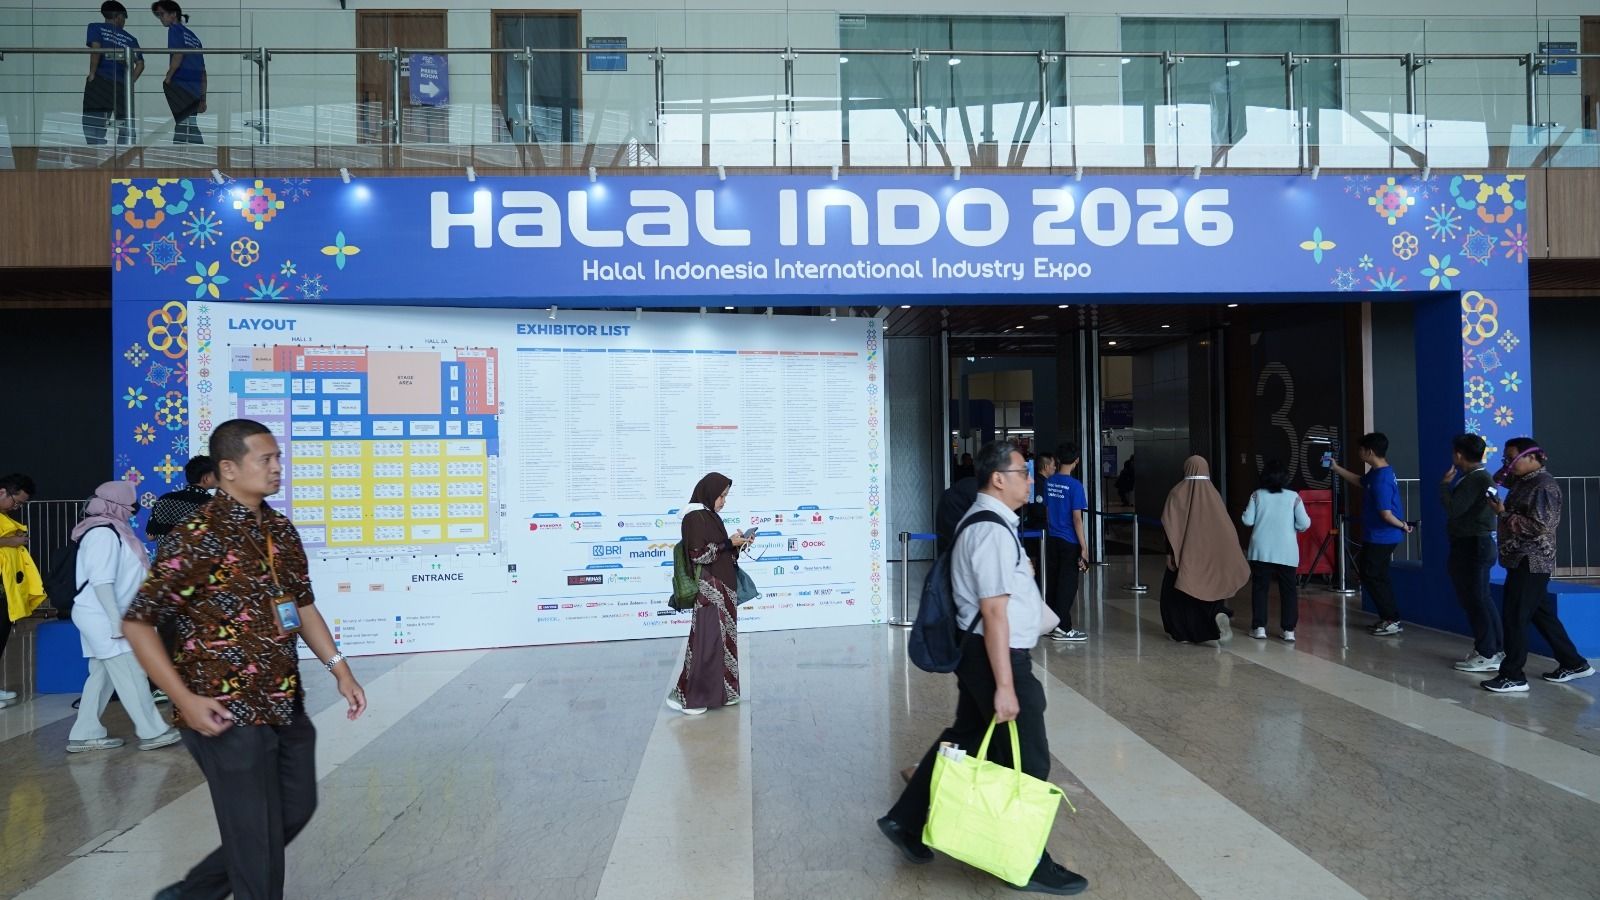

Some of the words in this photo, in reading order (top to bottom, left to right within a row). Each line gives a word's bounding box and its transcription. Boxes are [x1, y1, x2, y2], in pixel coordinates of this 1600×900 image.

[1032, 186, 1235, 247] 2026
[583, 259, 646, 281] Halal
[654, 259, 768, 281] Indonesia
[774, 258, 924, 280] International
[932, 257, 1025, 282] Industry
[1034, 257, 1092, 281] Expo
[228, 318, 297, 331] LAYOUT
[516, 323, 597, 336] EXHIBITOR
[600, 324, 631, 337] LIST
[605, 545, 622, 556] BRI
[629, 548, 666, 559] mandiri
[411, 573, 464, 583] ENTRANCE
[638, 610, 649, 618] KIS
